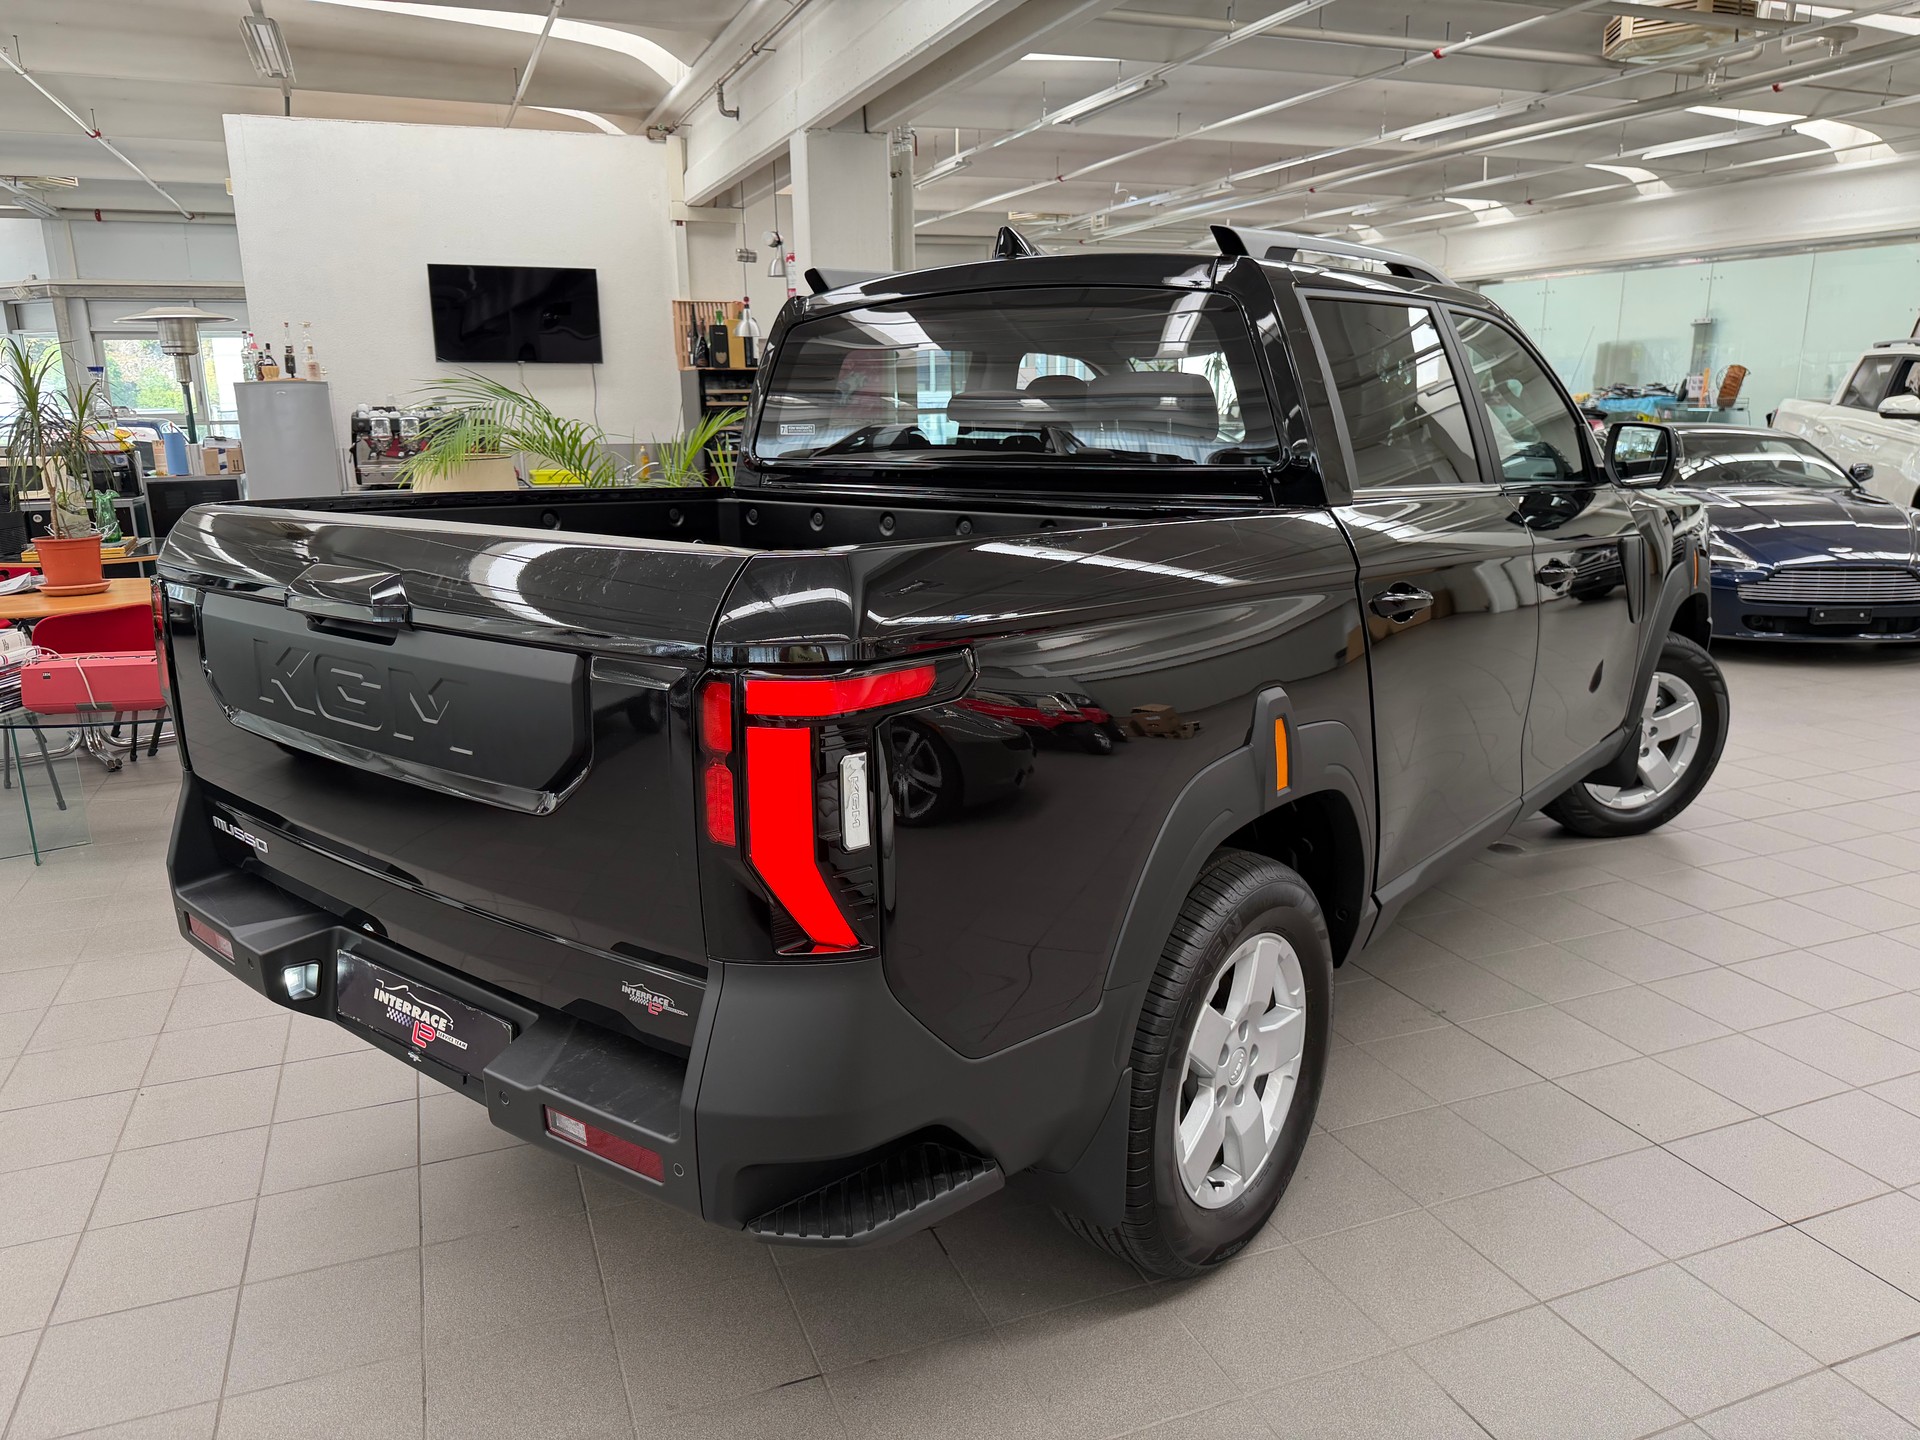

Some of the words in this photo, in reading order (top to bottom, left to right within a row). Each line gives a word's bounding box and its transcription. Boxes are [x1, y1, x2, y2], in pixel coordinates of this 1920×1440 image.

[253, 637, 475, 756] KGM
[848, 776, 861, 829] KGM
[212, 815, 269, 853] MUSSO
[373, 987, 448, 1031] INTERRACE
[621, 985, 669, 1006] INTERRACE
